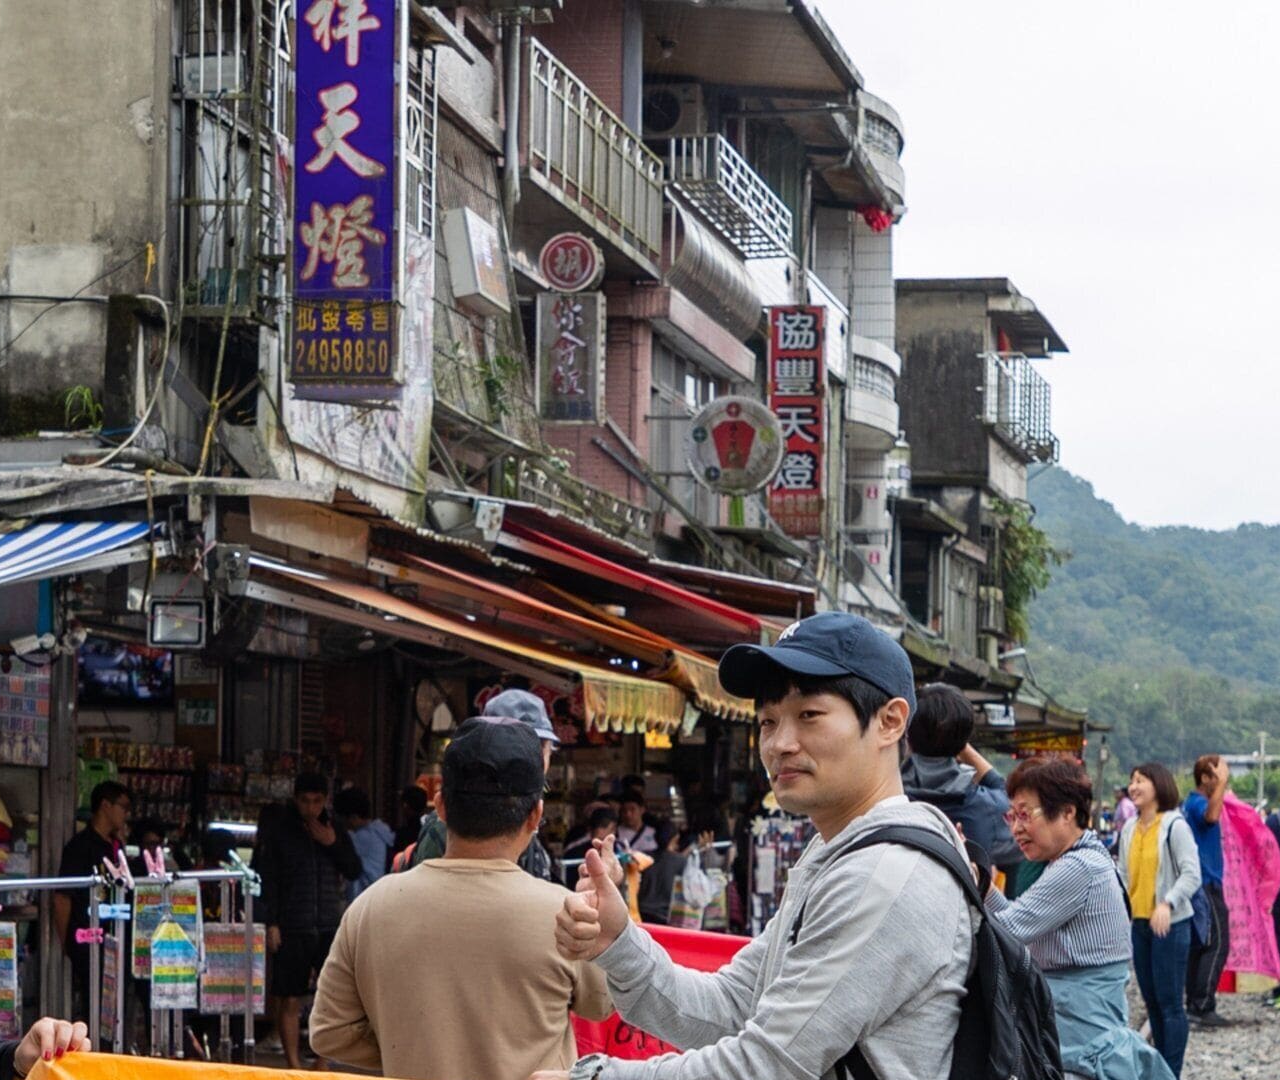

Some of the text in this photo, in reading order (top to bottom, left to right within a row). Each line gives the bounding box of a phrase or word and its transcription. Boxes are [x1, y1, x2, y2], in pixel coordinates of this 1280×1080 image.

[295, 338, 389, 373] 24958850
[772, 312, 816, 491] 協豐天燈
